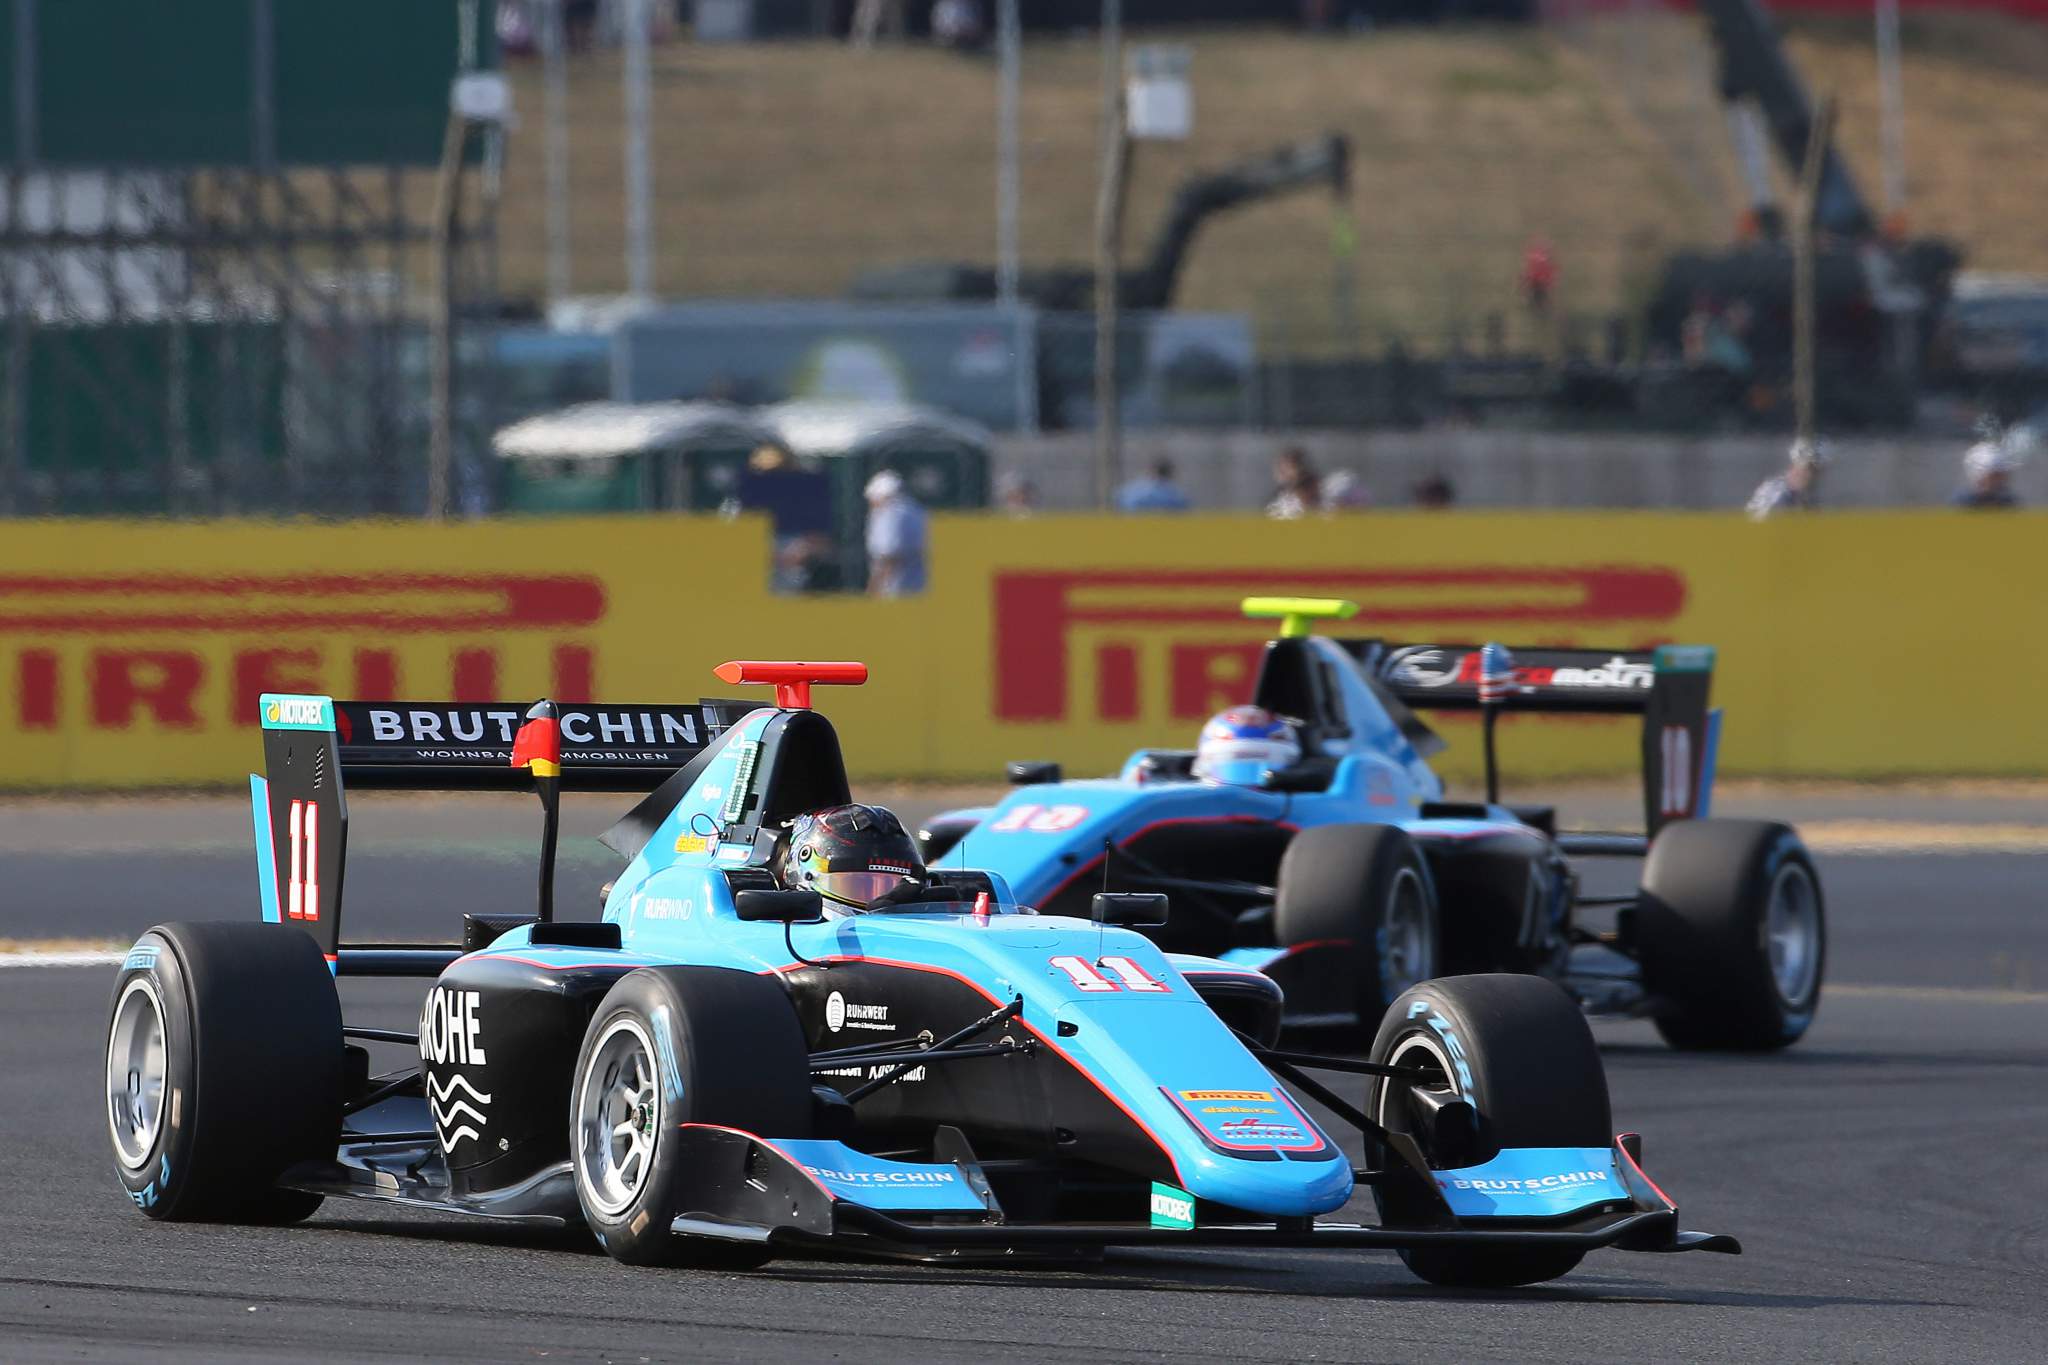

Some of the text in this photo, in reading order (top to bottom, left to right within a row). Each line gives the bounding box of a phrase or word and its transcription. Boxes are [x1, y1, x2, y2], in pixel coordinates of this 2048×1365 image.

[279, 699, 323, 725] MOTOREX
[368, 710, 698, 744] BRUTCHIN
[416, 750, 669, 761] WOHNBA MMOBILIEN
[289, 799, 318, 920] 11
[1048, 955, 1174, 993] 11
[846, 1003, 888, 1020] RUHRWERT
[804, 1165, 954, 1183] BRUTSCHIN
[1453, 1171, 1608, 1190] BRUTSCHIN
[1151, 1194, 1193, 1223] MOTOREX
